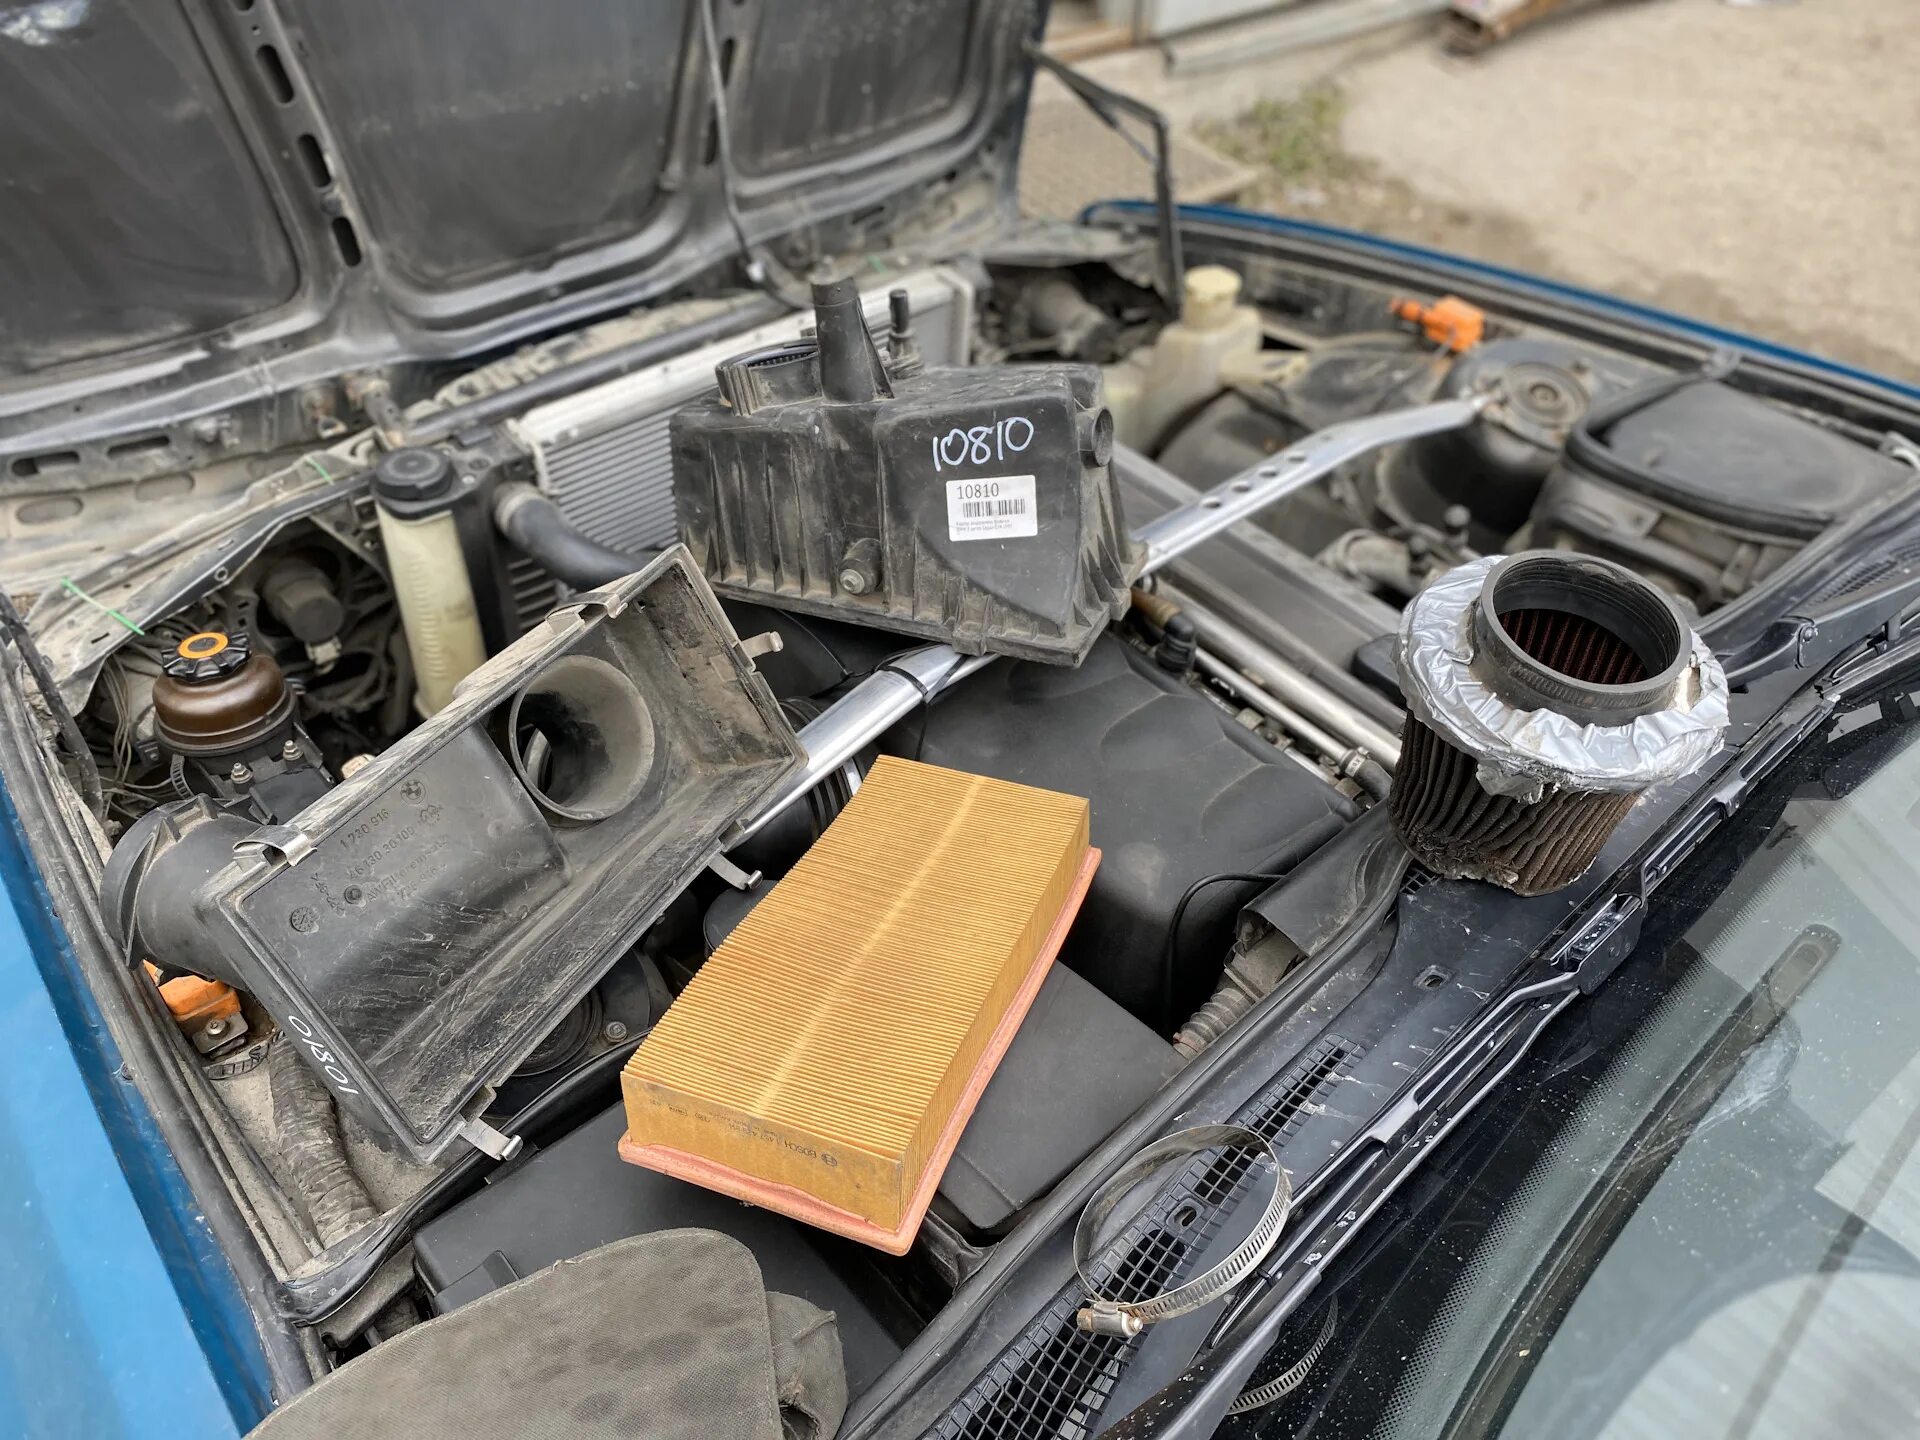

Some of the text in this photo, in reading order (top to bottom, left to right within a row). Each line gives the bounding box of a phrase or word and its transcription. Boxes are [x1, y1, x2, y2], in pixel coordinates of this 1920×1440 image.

[932, 416, 1034, 472] 10810
[957, 483, 999, 500] 10810
[347, 824, 370, 843] 730
[370, 808, 389, 826] 916
[288, 1015, 359, 1094] 10810
[784, 1140, 817, 1159] BOSCH
